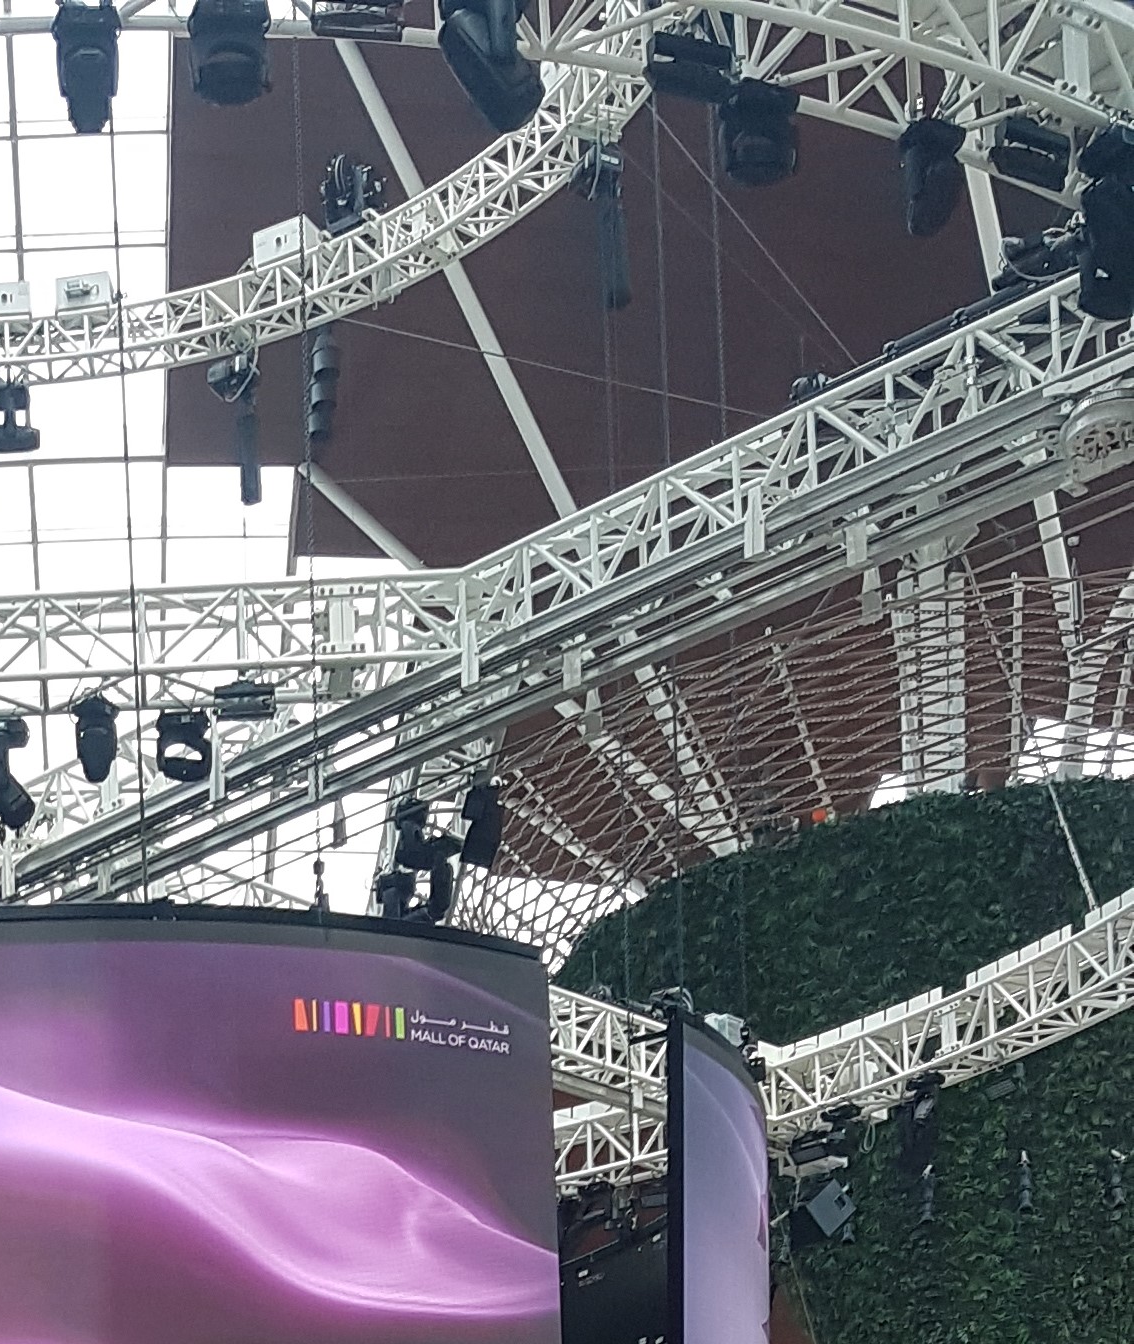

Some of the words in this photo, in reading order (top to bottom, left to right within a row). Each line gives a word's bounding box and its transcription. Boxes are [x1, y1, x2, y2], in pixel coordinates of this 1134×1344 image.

[410, 1009, 456, 1026] مول
[461, 1020, 510, 1035] قطر
[410, 1029, 446, 1045] MALL
[448, 1033, 466, 1047] OF
[468, 1037, 510, 1054] QATAR
